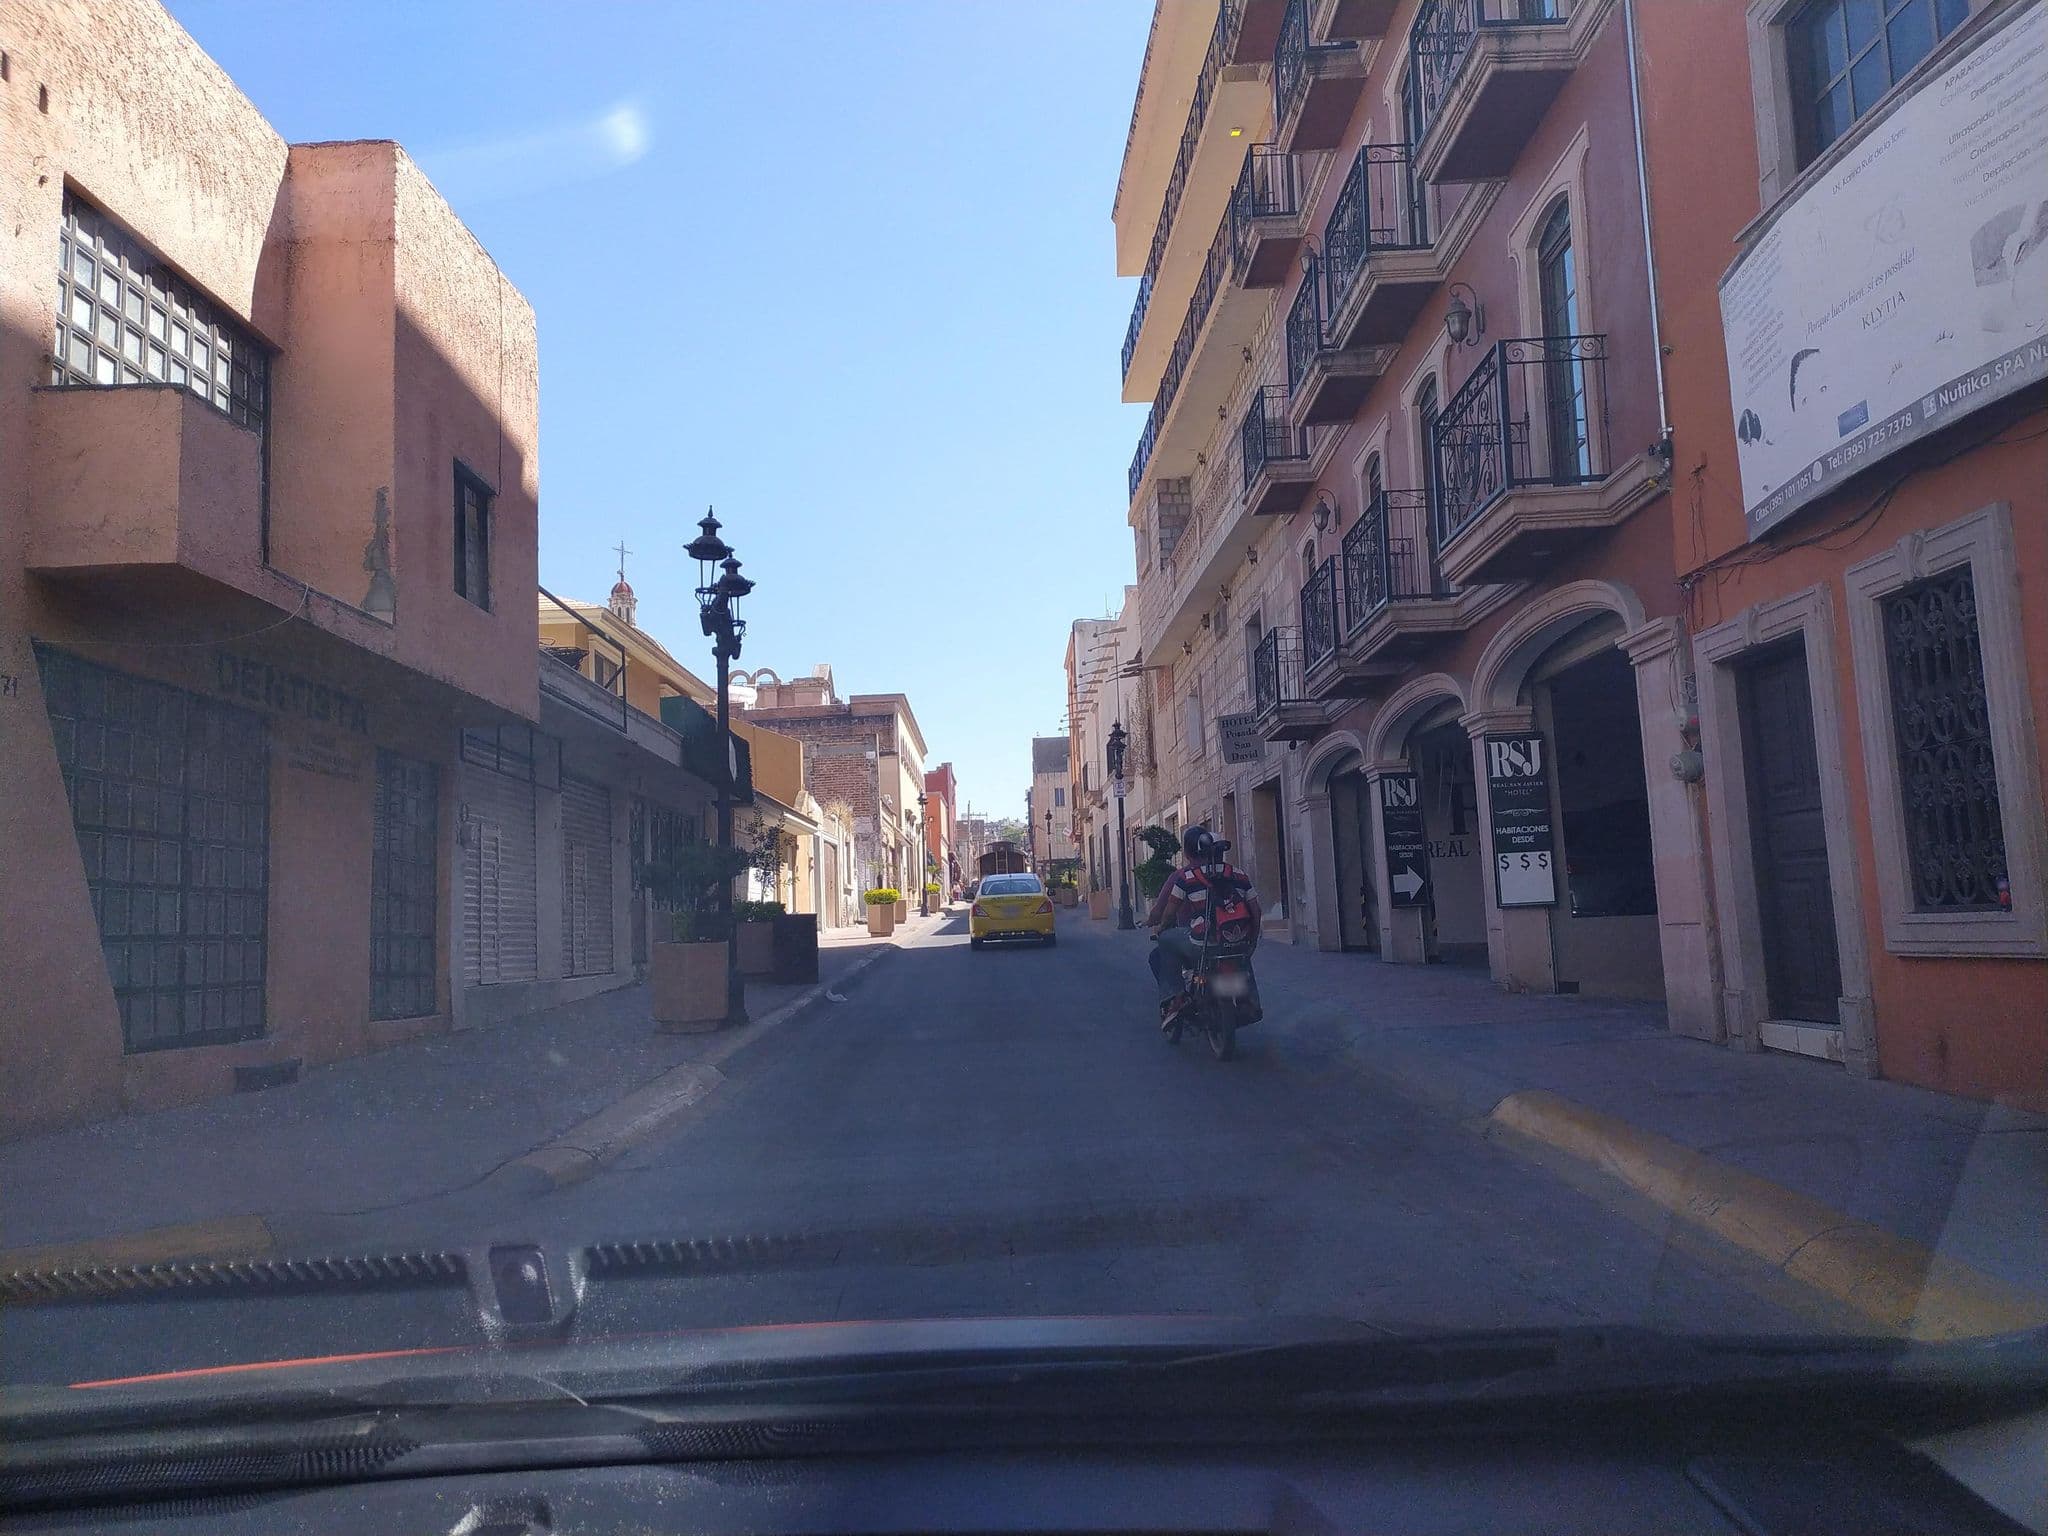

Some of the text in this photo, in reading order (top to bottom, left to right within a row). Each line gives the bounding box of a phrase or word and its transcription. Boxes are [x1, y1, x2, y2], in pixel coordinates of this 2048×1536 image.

[1861, 290, 1906, 330] KLYTIA
[1827, 452, 1843, 471] Tel:
[1844, 438, 1866, 463] (395)
[1868, 427, 1885, 449] 725
[1887, 412, 1913, 437] 7378
[1938, 372, 1991, 408] Nutrika
[1994, 354, 2025, 380] SPA
[1231, 749, 1258, 761] David
[1233, 741, 1251, 750] San
[1487, 739, 1542, 778] RSJ
[1382, 777, 1417, 807] RSJ
[1496, 824, 1550, 835] HABITACIONES
[1511, 834, 1536, 844] DESDE
